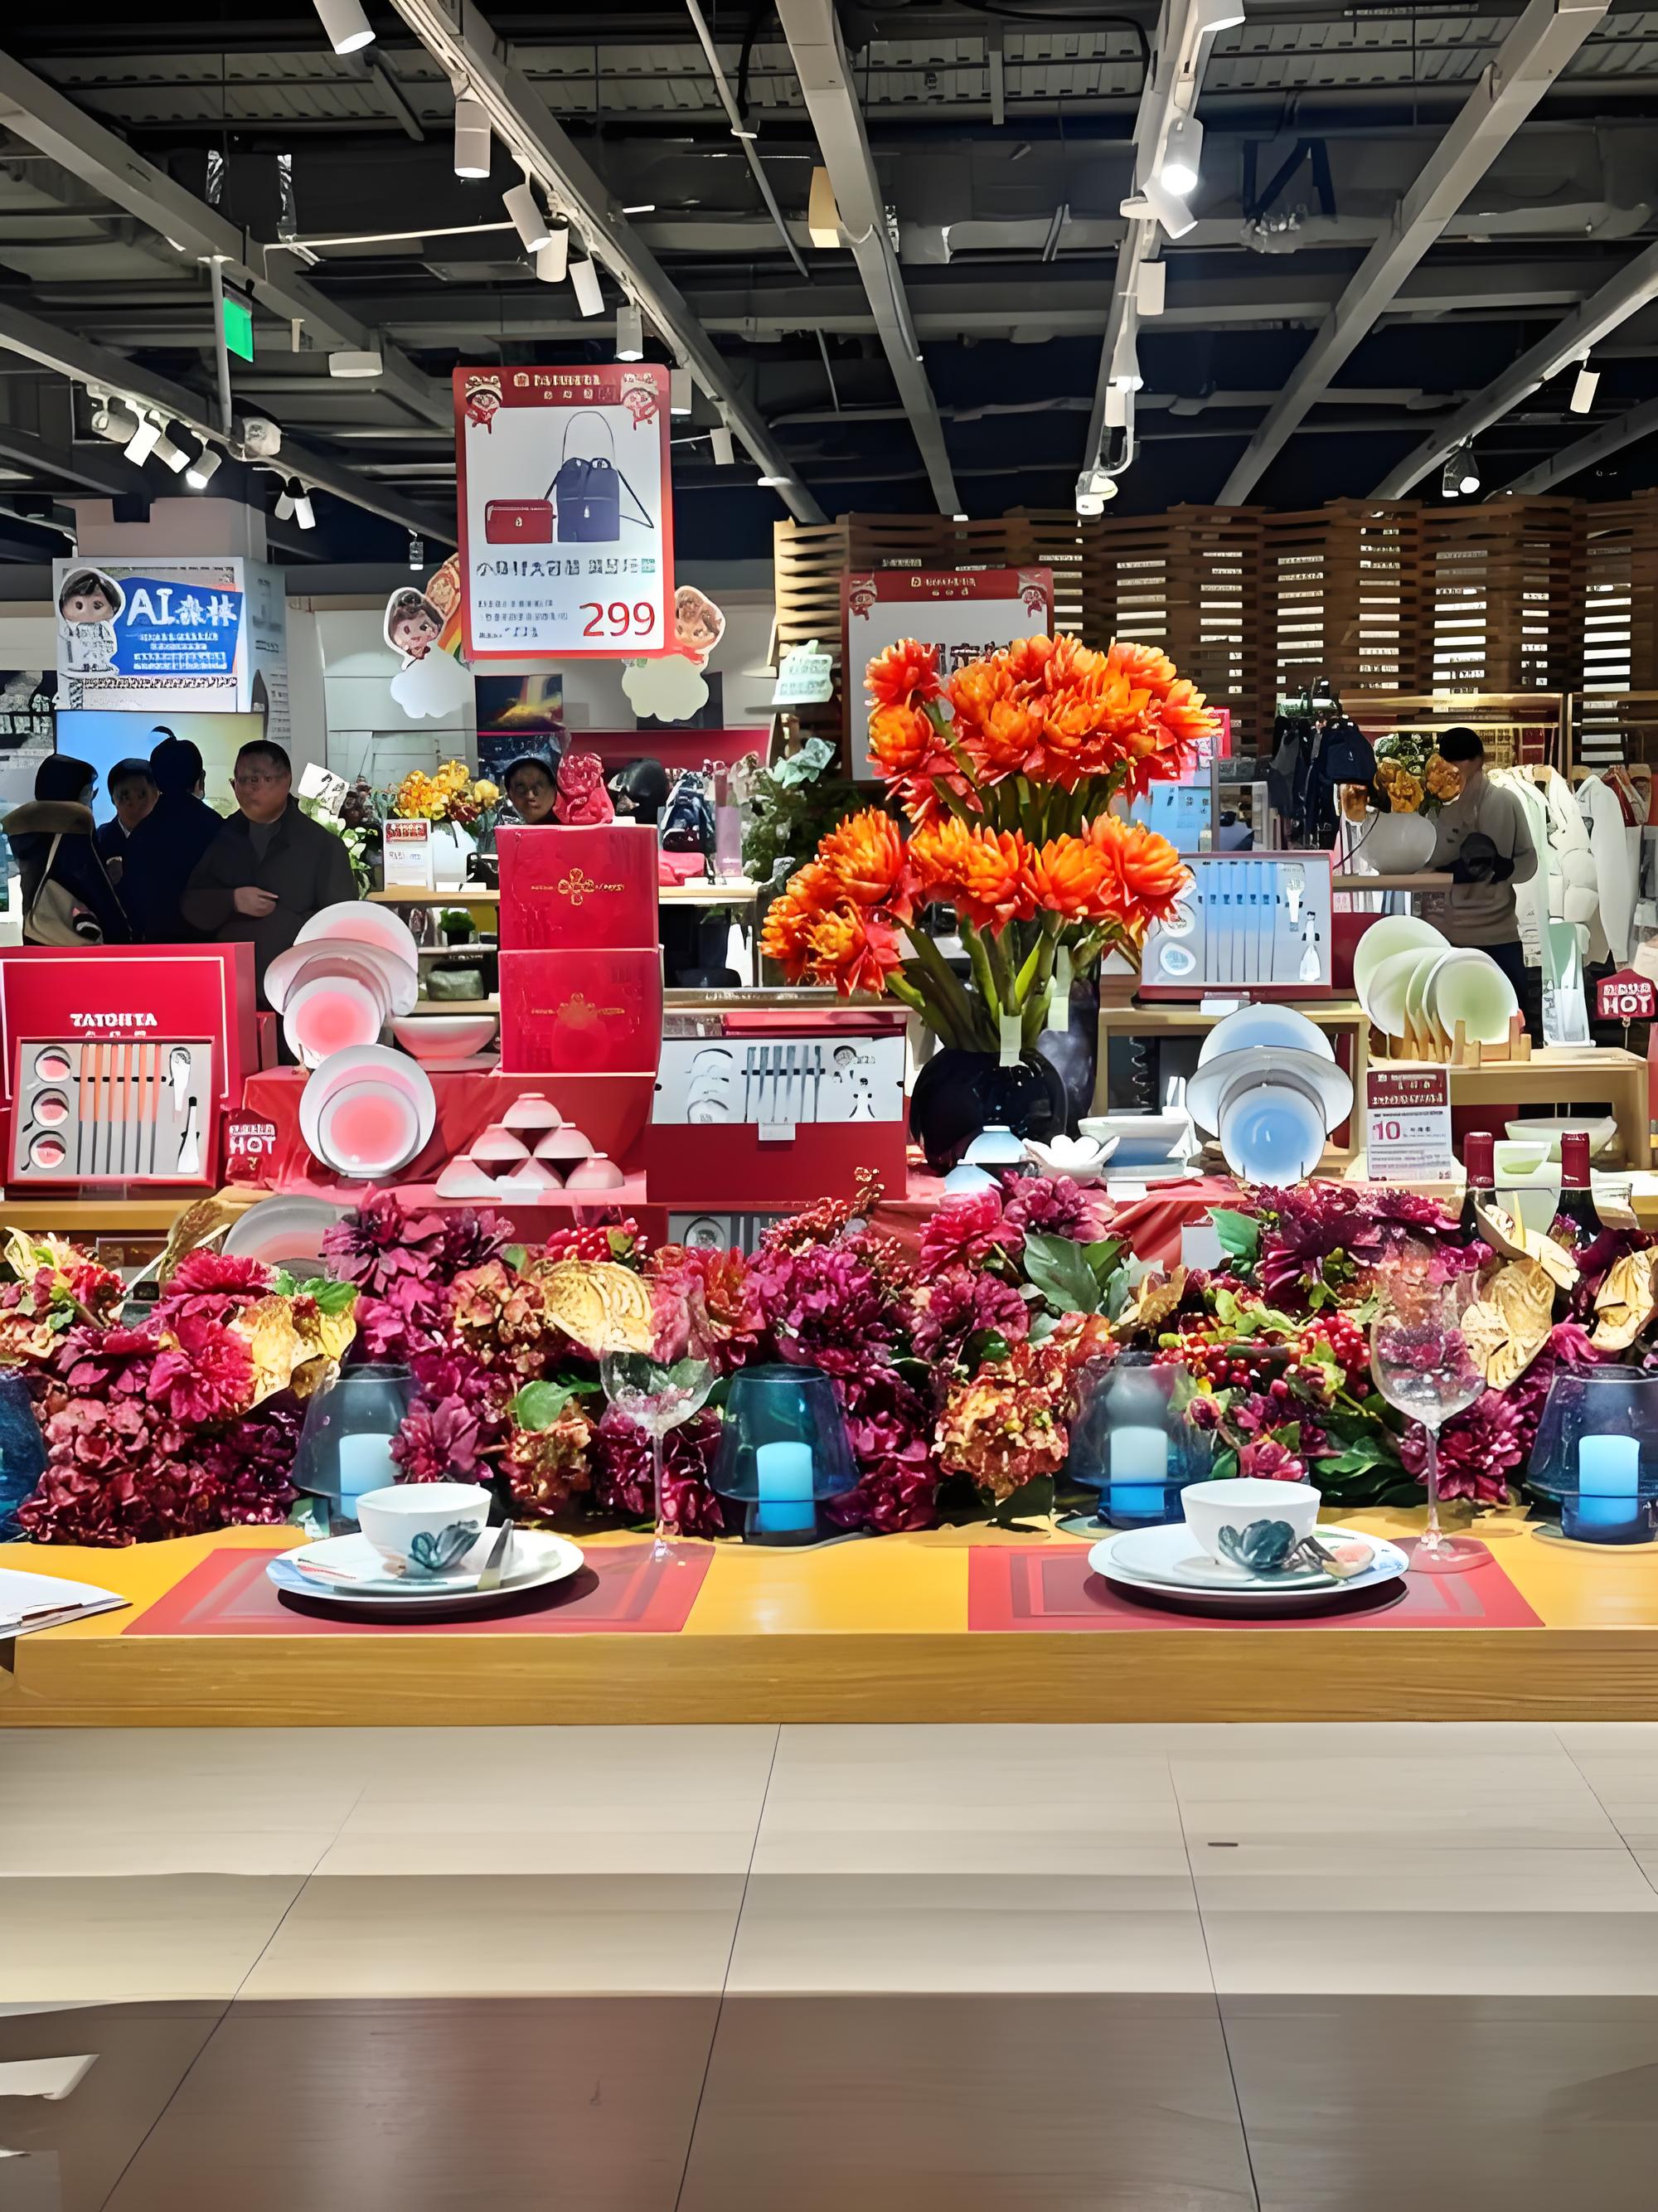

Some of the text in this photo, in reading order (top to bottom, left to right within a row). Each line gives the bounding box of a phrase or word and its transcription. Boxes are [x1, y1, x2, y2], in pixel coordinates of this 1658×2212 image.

[579, 602, 655, 637] 299
[1602, 995, 1651, 1015] HOT
[1373, 1121, 1401, 1141] 10
[229, 1136, 276, 1155] HOT
